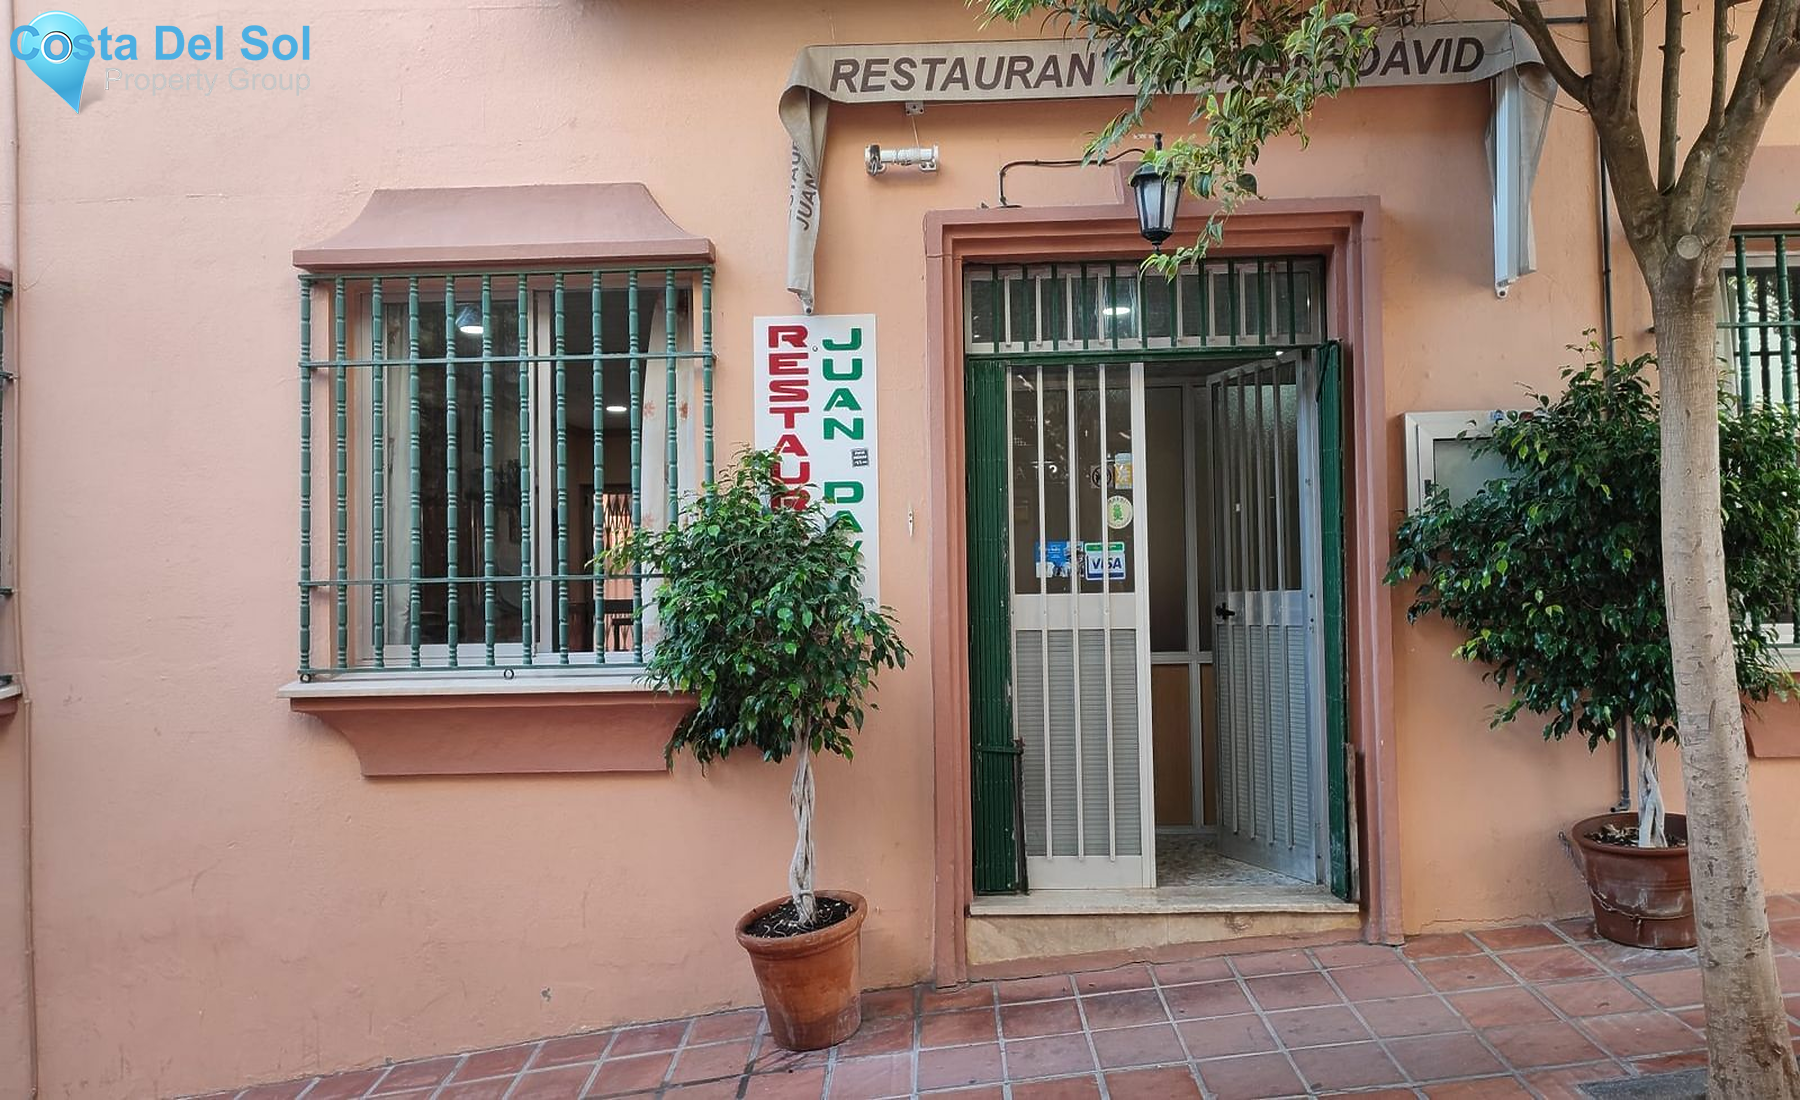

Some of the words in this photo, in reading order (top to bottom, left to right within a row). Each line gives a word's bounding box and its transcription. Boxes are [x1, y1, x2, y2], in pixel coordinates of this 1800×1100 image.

[829, 52, 1136, 93] RESTAURAN
[1358, 37, 1485, 77] DAVID
[768, 325, 810, 513] RESTAUR
[822, 328, 864, 440] JUAN
[1091, 557, 1122, 570] VISA
